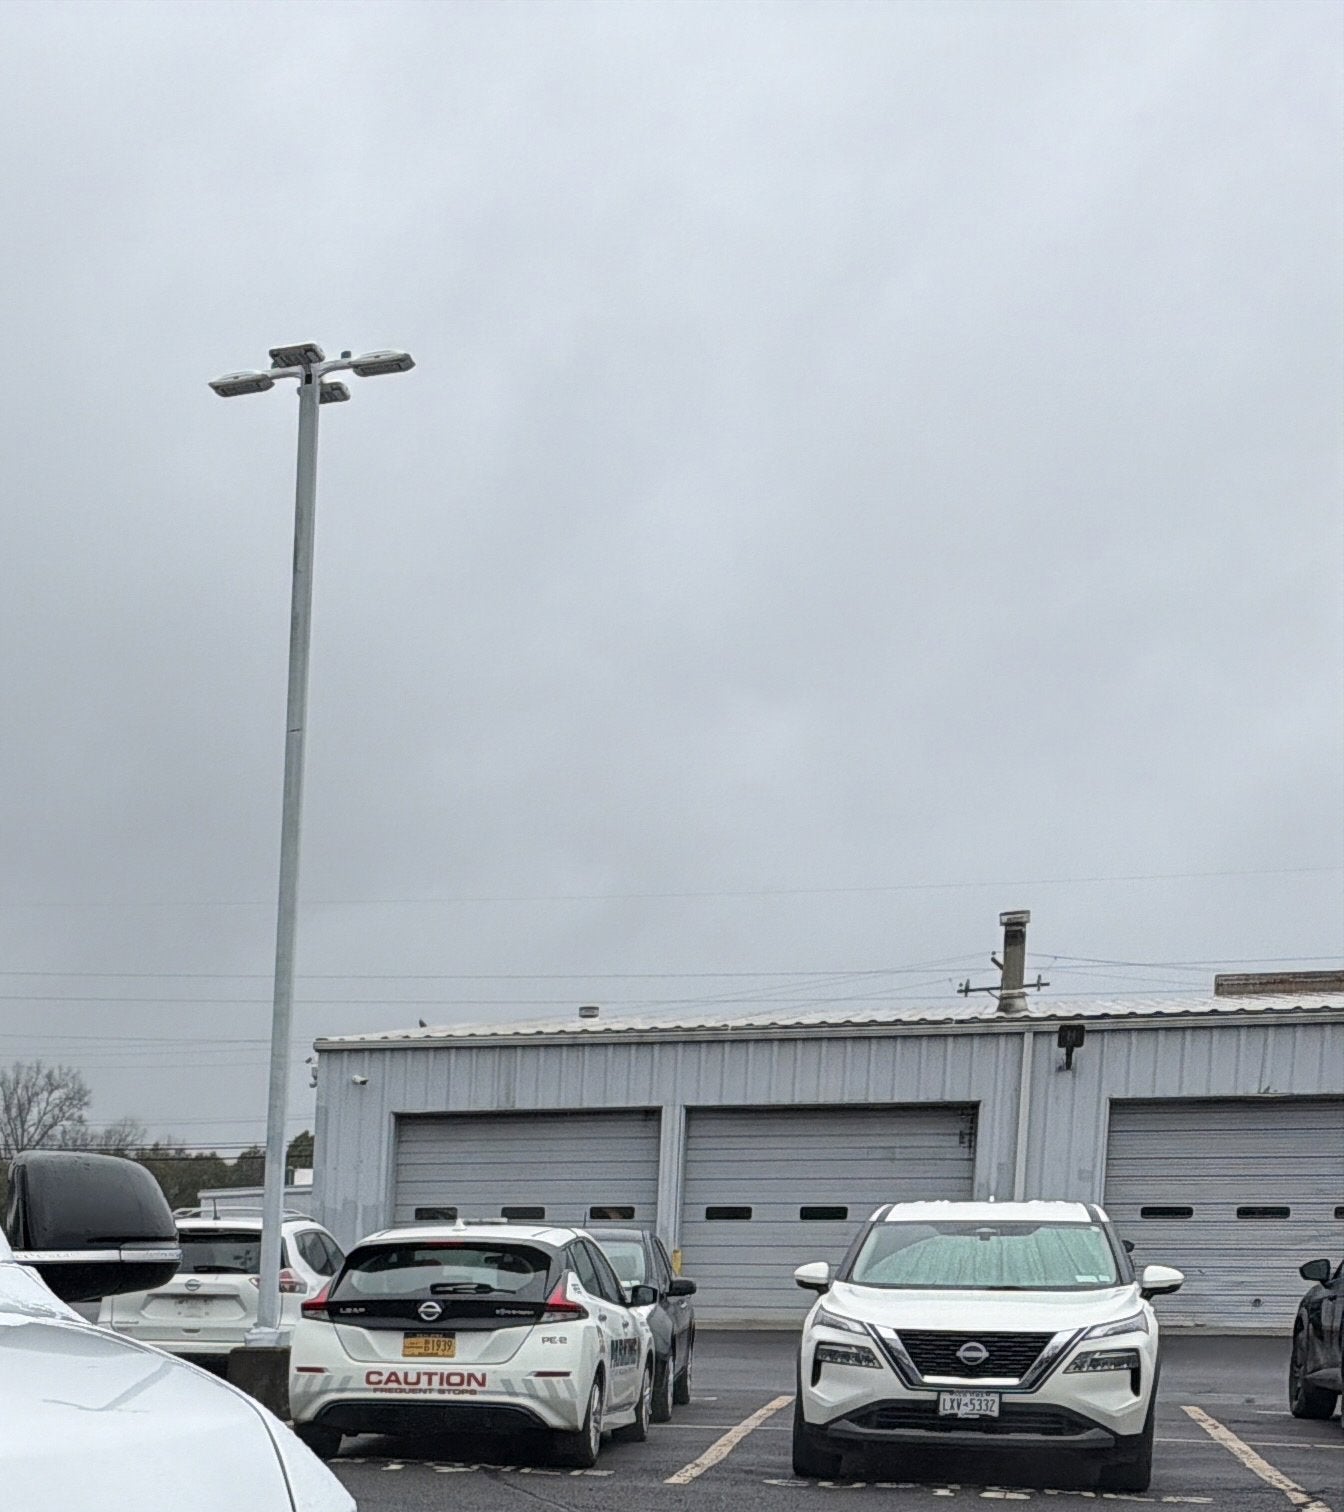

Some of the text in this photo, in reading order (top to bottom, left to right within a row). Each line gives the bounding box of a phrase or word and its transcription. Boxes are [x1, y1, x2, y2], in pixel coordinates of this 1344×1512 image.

[365, 1370, 487, 1388] CAUTION
[373, 1387, 478, 1396] FREQUENT STOPS
